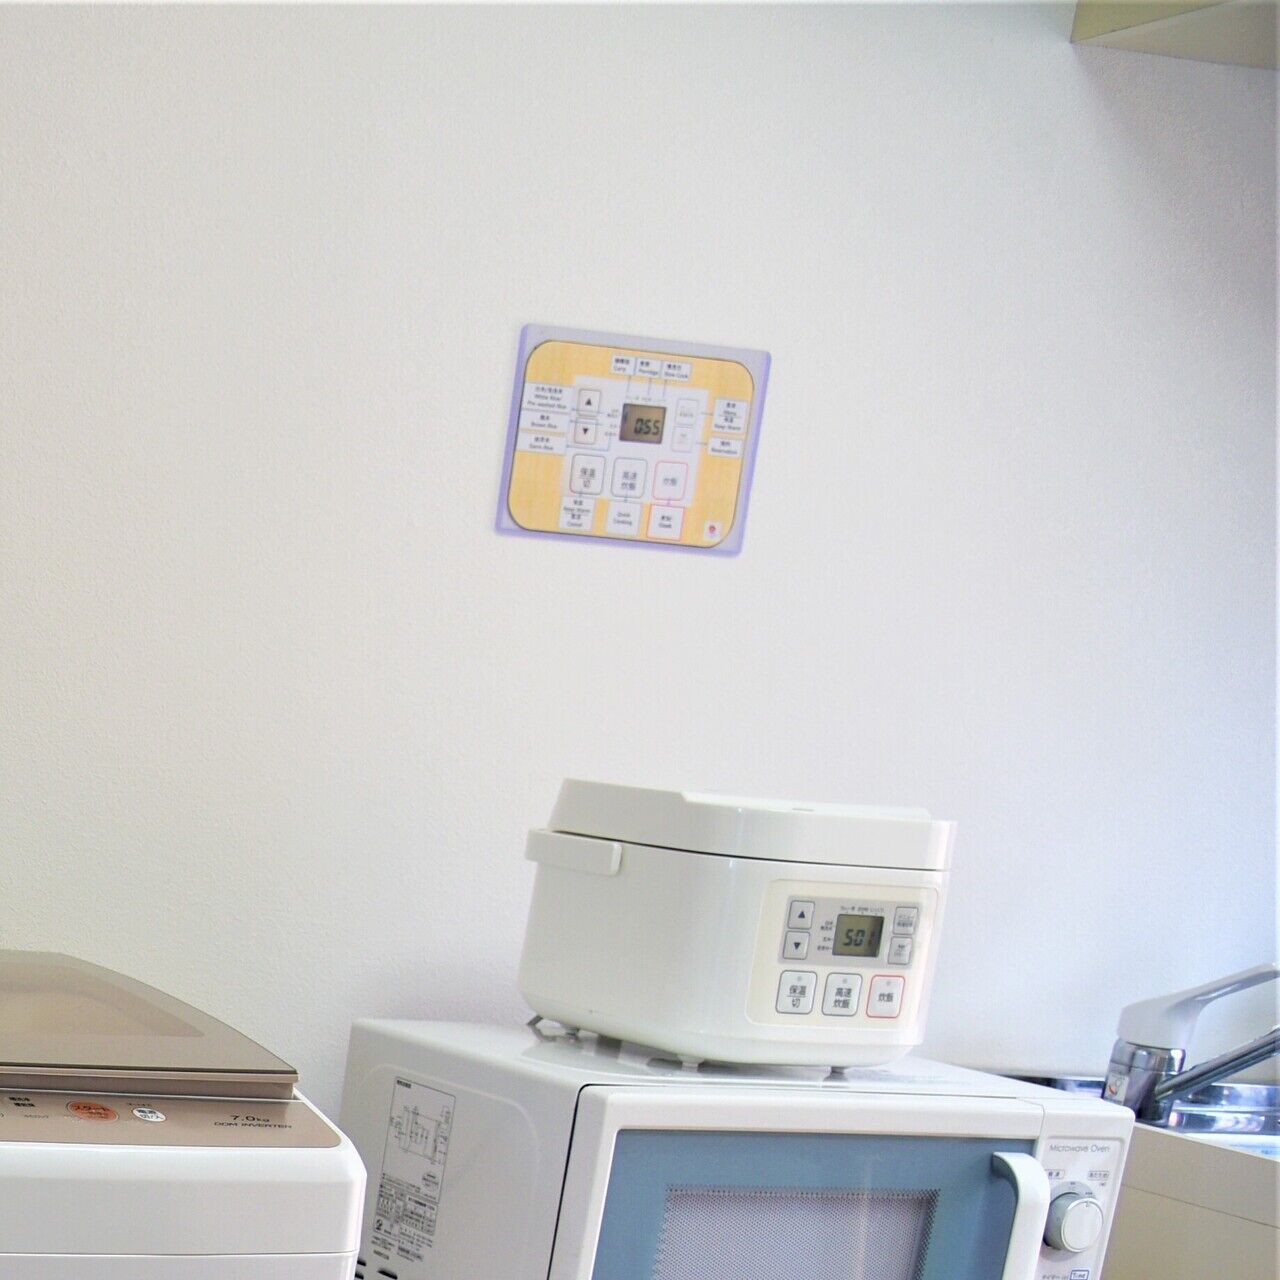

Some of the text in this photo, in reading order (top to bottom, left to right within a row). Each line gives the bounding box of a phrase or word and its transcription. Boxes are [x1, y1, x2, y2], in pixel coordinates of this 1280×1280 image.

[789, 985, 806, 996] 保温
[792, 998, 800, 1008] 切
[1050, 1144, 1110, 1152] Microwave Oven
